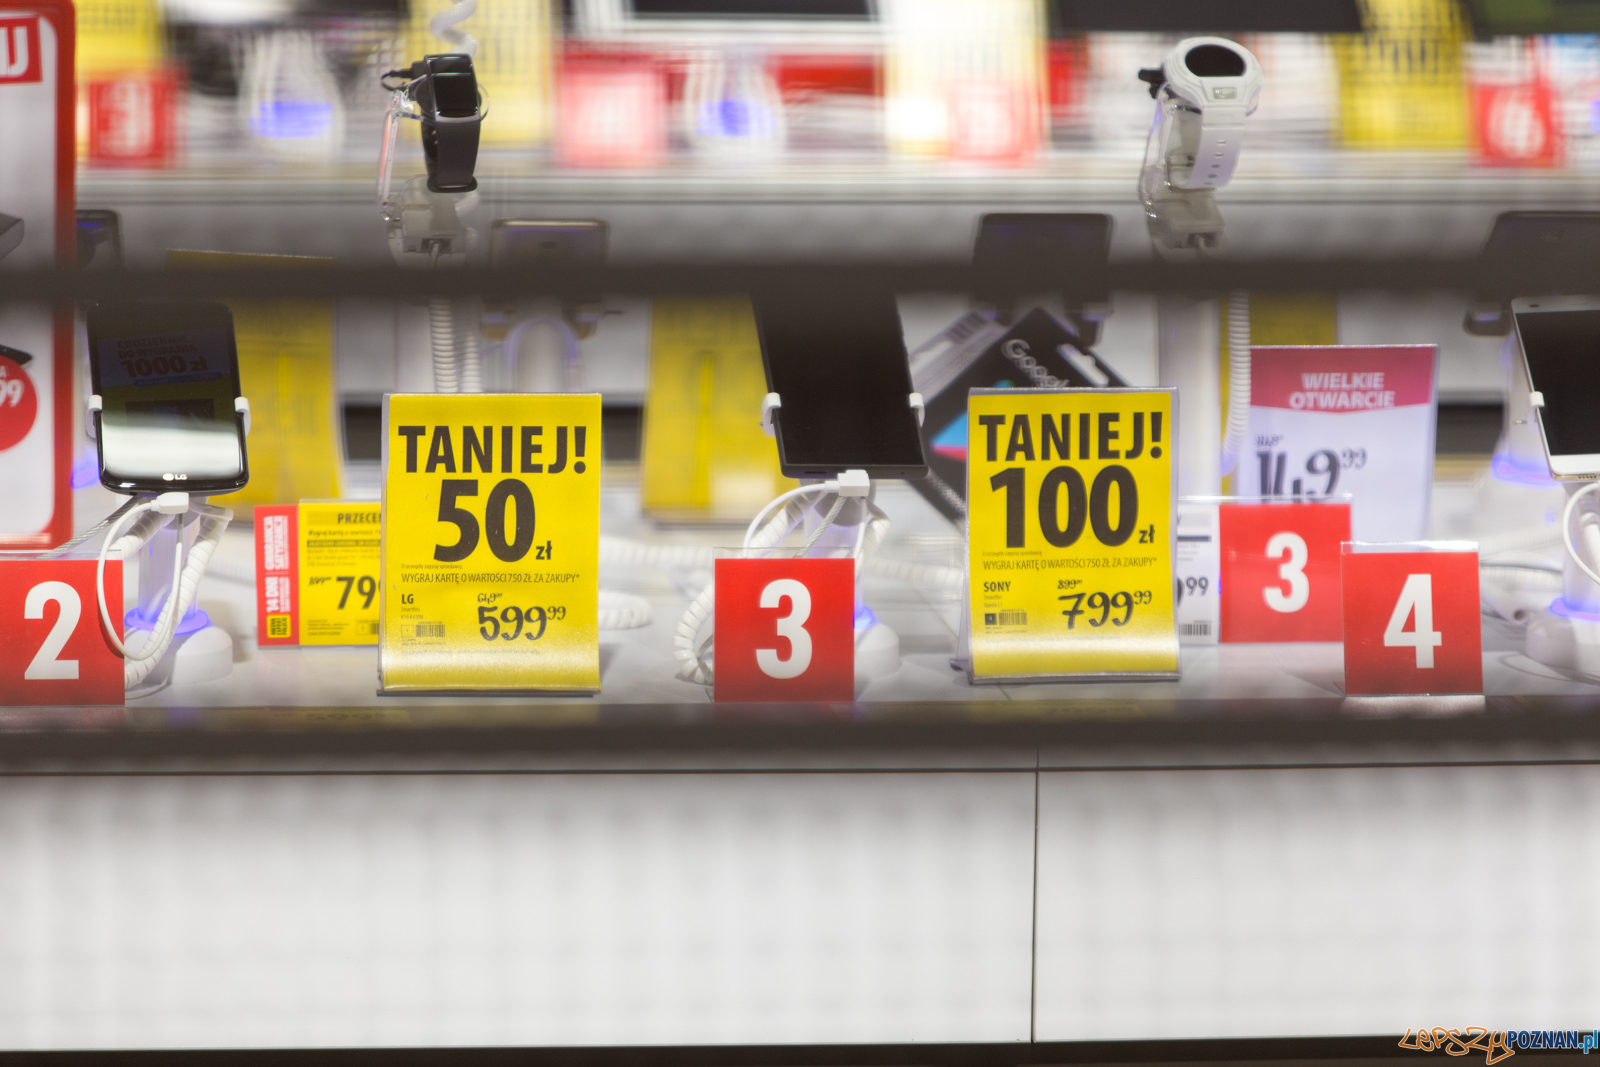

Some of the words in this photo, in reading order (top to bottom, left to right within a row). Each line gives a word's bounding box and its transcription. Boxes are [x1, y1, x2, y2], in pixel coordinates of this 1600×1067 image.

[118, 350, 135, 359] DO
[136, 344, 197, 358] WYGRANIA
[120, 355, 187, 378] 1000
[189, 355, 208, 372] zł
[1301, 372, 1385, 389] WIELKIE
[1289, 391, 1396, 409] OTWARCIE
[978, 411, 1163, 462] TANIEJ!
[398, 425, 587, 474] TANIEJ!
[989, 465, 1139, 548] 100
[1139, 524, 1155, 544] zł
[433, 478, 536, 563] 50
[535, 540, 552, 560] zł
[983, 560, 1015, 570] WYGRAJ
[1016, 559, 1040, 571] KARTĘ
[1041, 559, 1047, 569] O
[1048, 557, 1086, 569] WARTOŚCI
[1086, 558, 1100, 568] 750
[1101, 558, 1110, 568] ZŁ
[1112, 557, 1122, 567] ZA
[1263, 531, 1310, 613] 3
[265, 576, 279, 598] DNI
[401, 573, 434, 583] WYGRAJ
[435, 573, 460, 585] KARTĘ
[461, 573, 467, 583] O
[468, 571, 507, 583] WARTOŚCI
[508, 573, 522, 583] 750
[523, 573, 532, 583] ZŁ
[533, 573, 543, 583] ZA
[983, 581, 1011, 592] SONY
[336, 575, 381, 610] 79
[401, 593, 414, 605] LG
[266, 599, 279, 613] 14
[24, 580, 82, 680] 2
[756, 578, 813, 679] 3
[1383, 573, 1442, 669] 4
